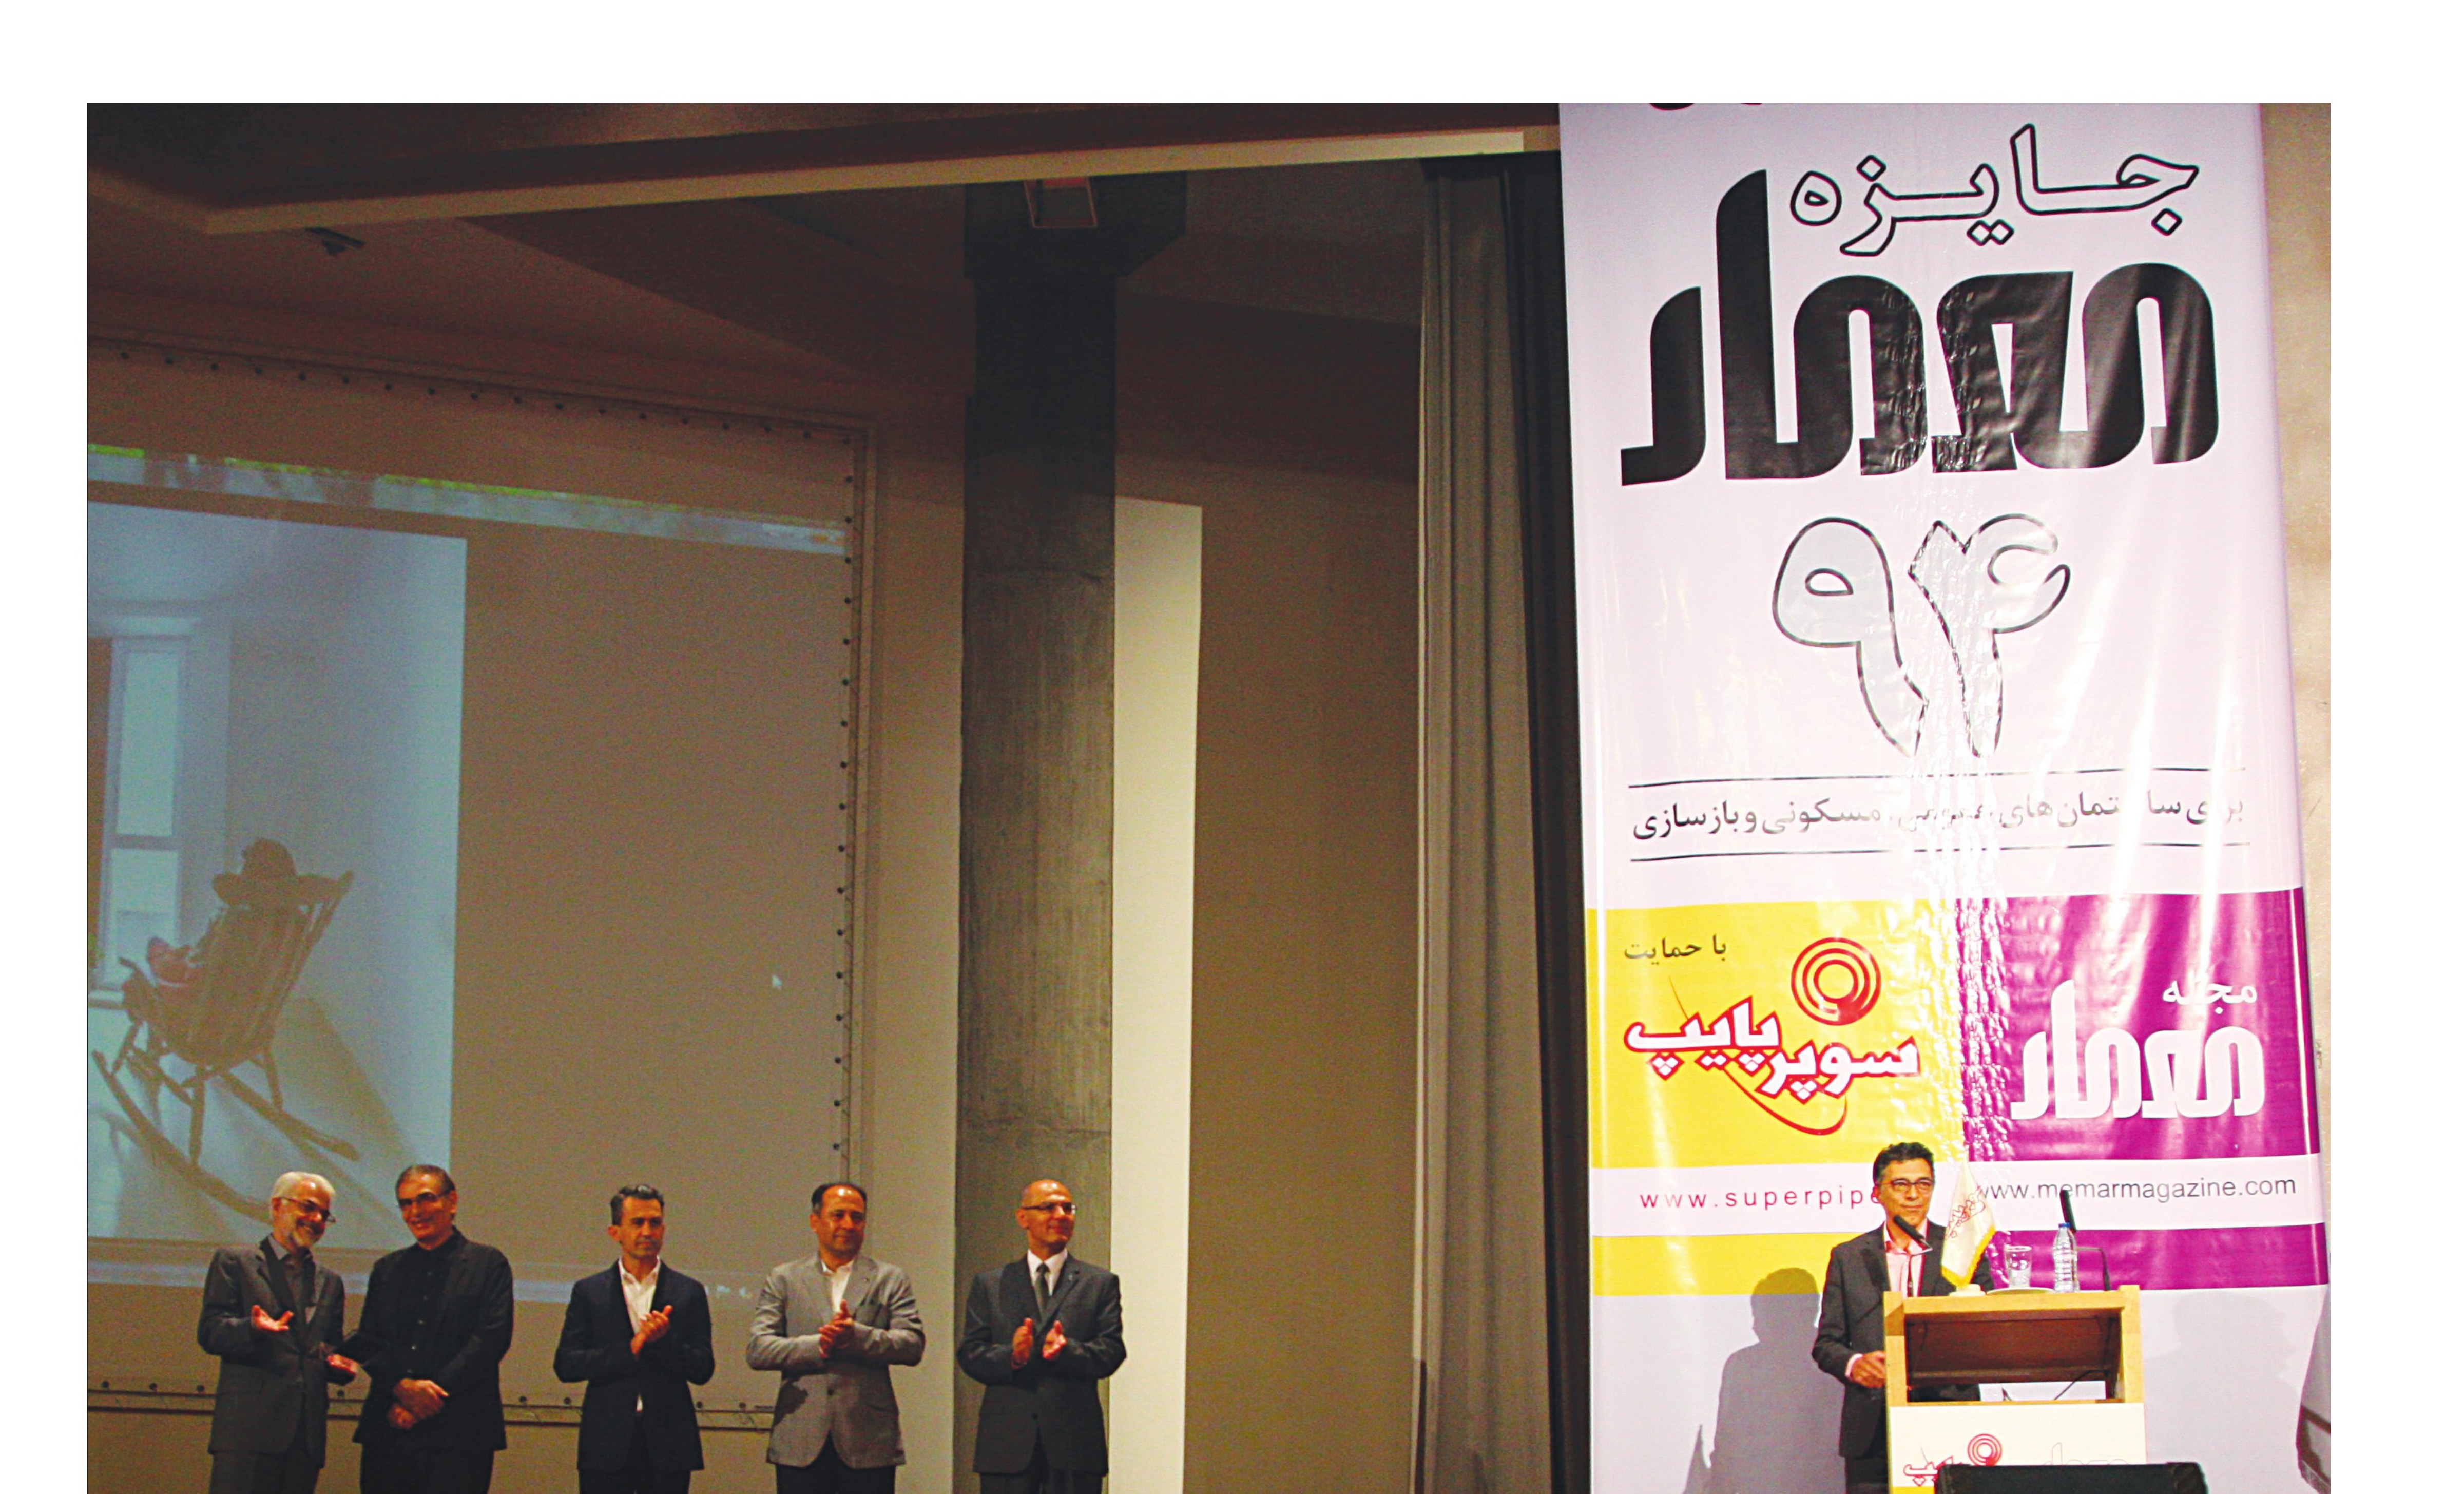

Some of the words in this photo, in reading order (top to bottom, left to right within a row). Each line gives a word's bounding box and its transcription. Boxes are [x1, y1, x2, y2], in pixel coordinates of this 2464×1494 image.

[1789, 123, 2200, 256] جایزه
[1621, 169, 2219, 486] معمار
[1761, 797, 1882, 834] مسکونی
[2186, 798, 2244, 825] بری
[1624, 937, 1702, 965] حمایت
[1712, 933, 1728, 962] با
[1623, 995, 1783, 1081] پایپ
[1755, 1036, 1921, 1105] سوپر
[2010, 978, 2266, 1121] معمار
